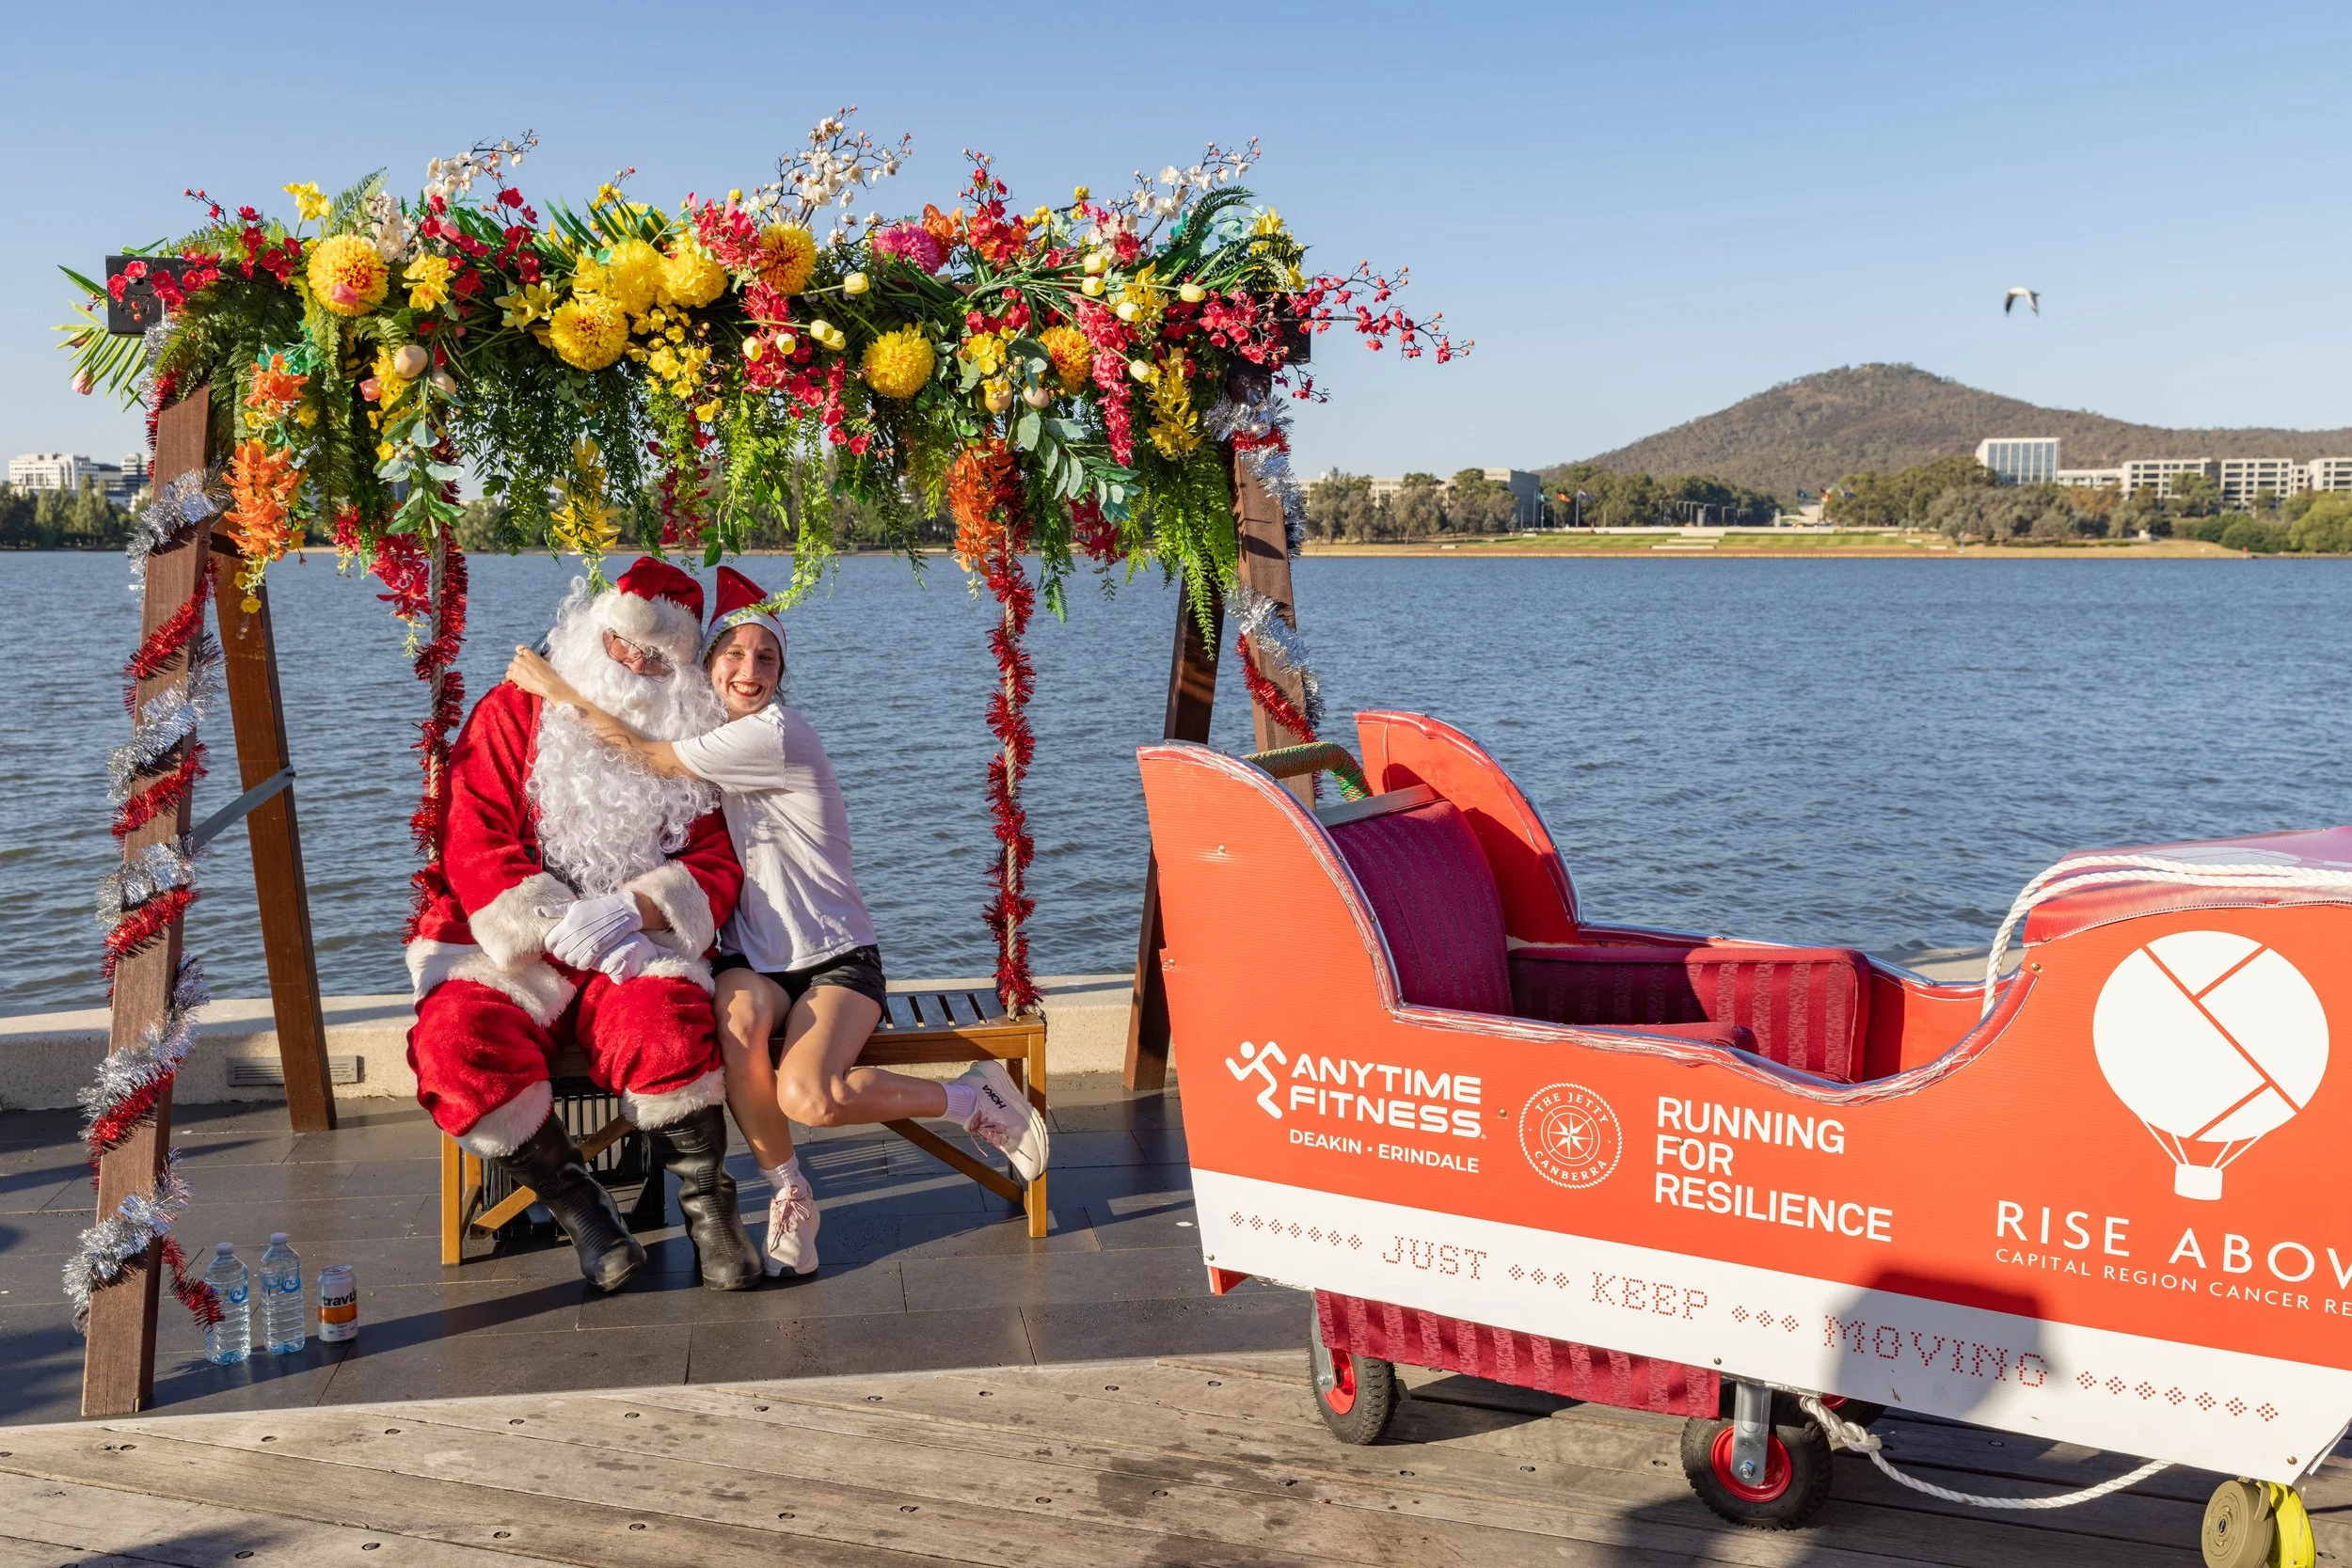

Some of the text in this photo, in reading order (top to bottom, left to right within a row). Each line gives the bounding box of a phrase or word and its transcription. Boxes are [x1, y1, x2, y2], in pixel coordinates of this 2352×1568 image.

[982, 1085, 1007, 1109] HOKA
[1290, 1053, 1483, 1106] ANYTIME
[1290, 1085, 1483, 1139] FITNESS
[1534, 1092, 1609, 1123] THE JETTY
[1657, 1096, 1845, 1154] RUNNING
[1290, 1128, 1480, 1174] DEAKIN ERINDALE
[1534, 1150, 1608, 1181] CANBERRA
[1656, 1133, 1734, 1177] FOR
[1655, 1172, 1893, 1243] RESILIENCE
[1995, 1199, 2131, 1258] RISE
[1994, 1248, 2091, 1276] CAPITAL
[2104, 1264, 2198, 1293] REGION
[2209, 1281, 2311, 1310] CANCER
[1382, 1235, 2048, 1388] JUST KEEP MOVING
